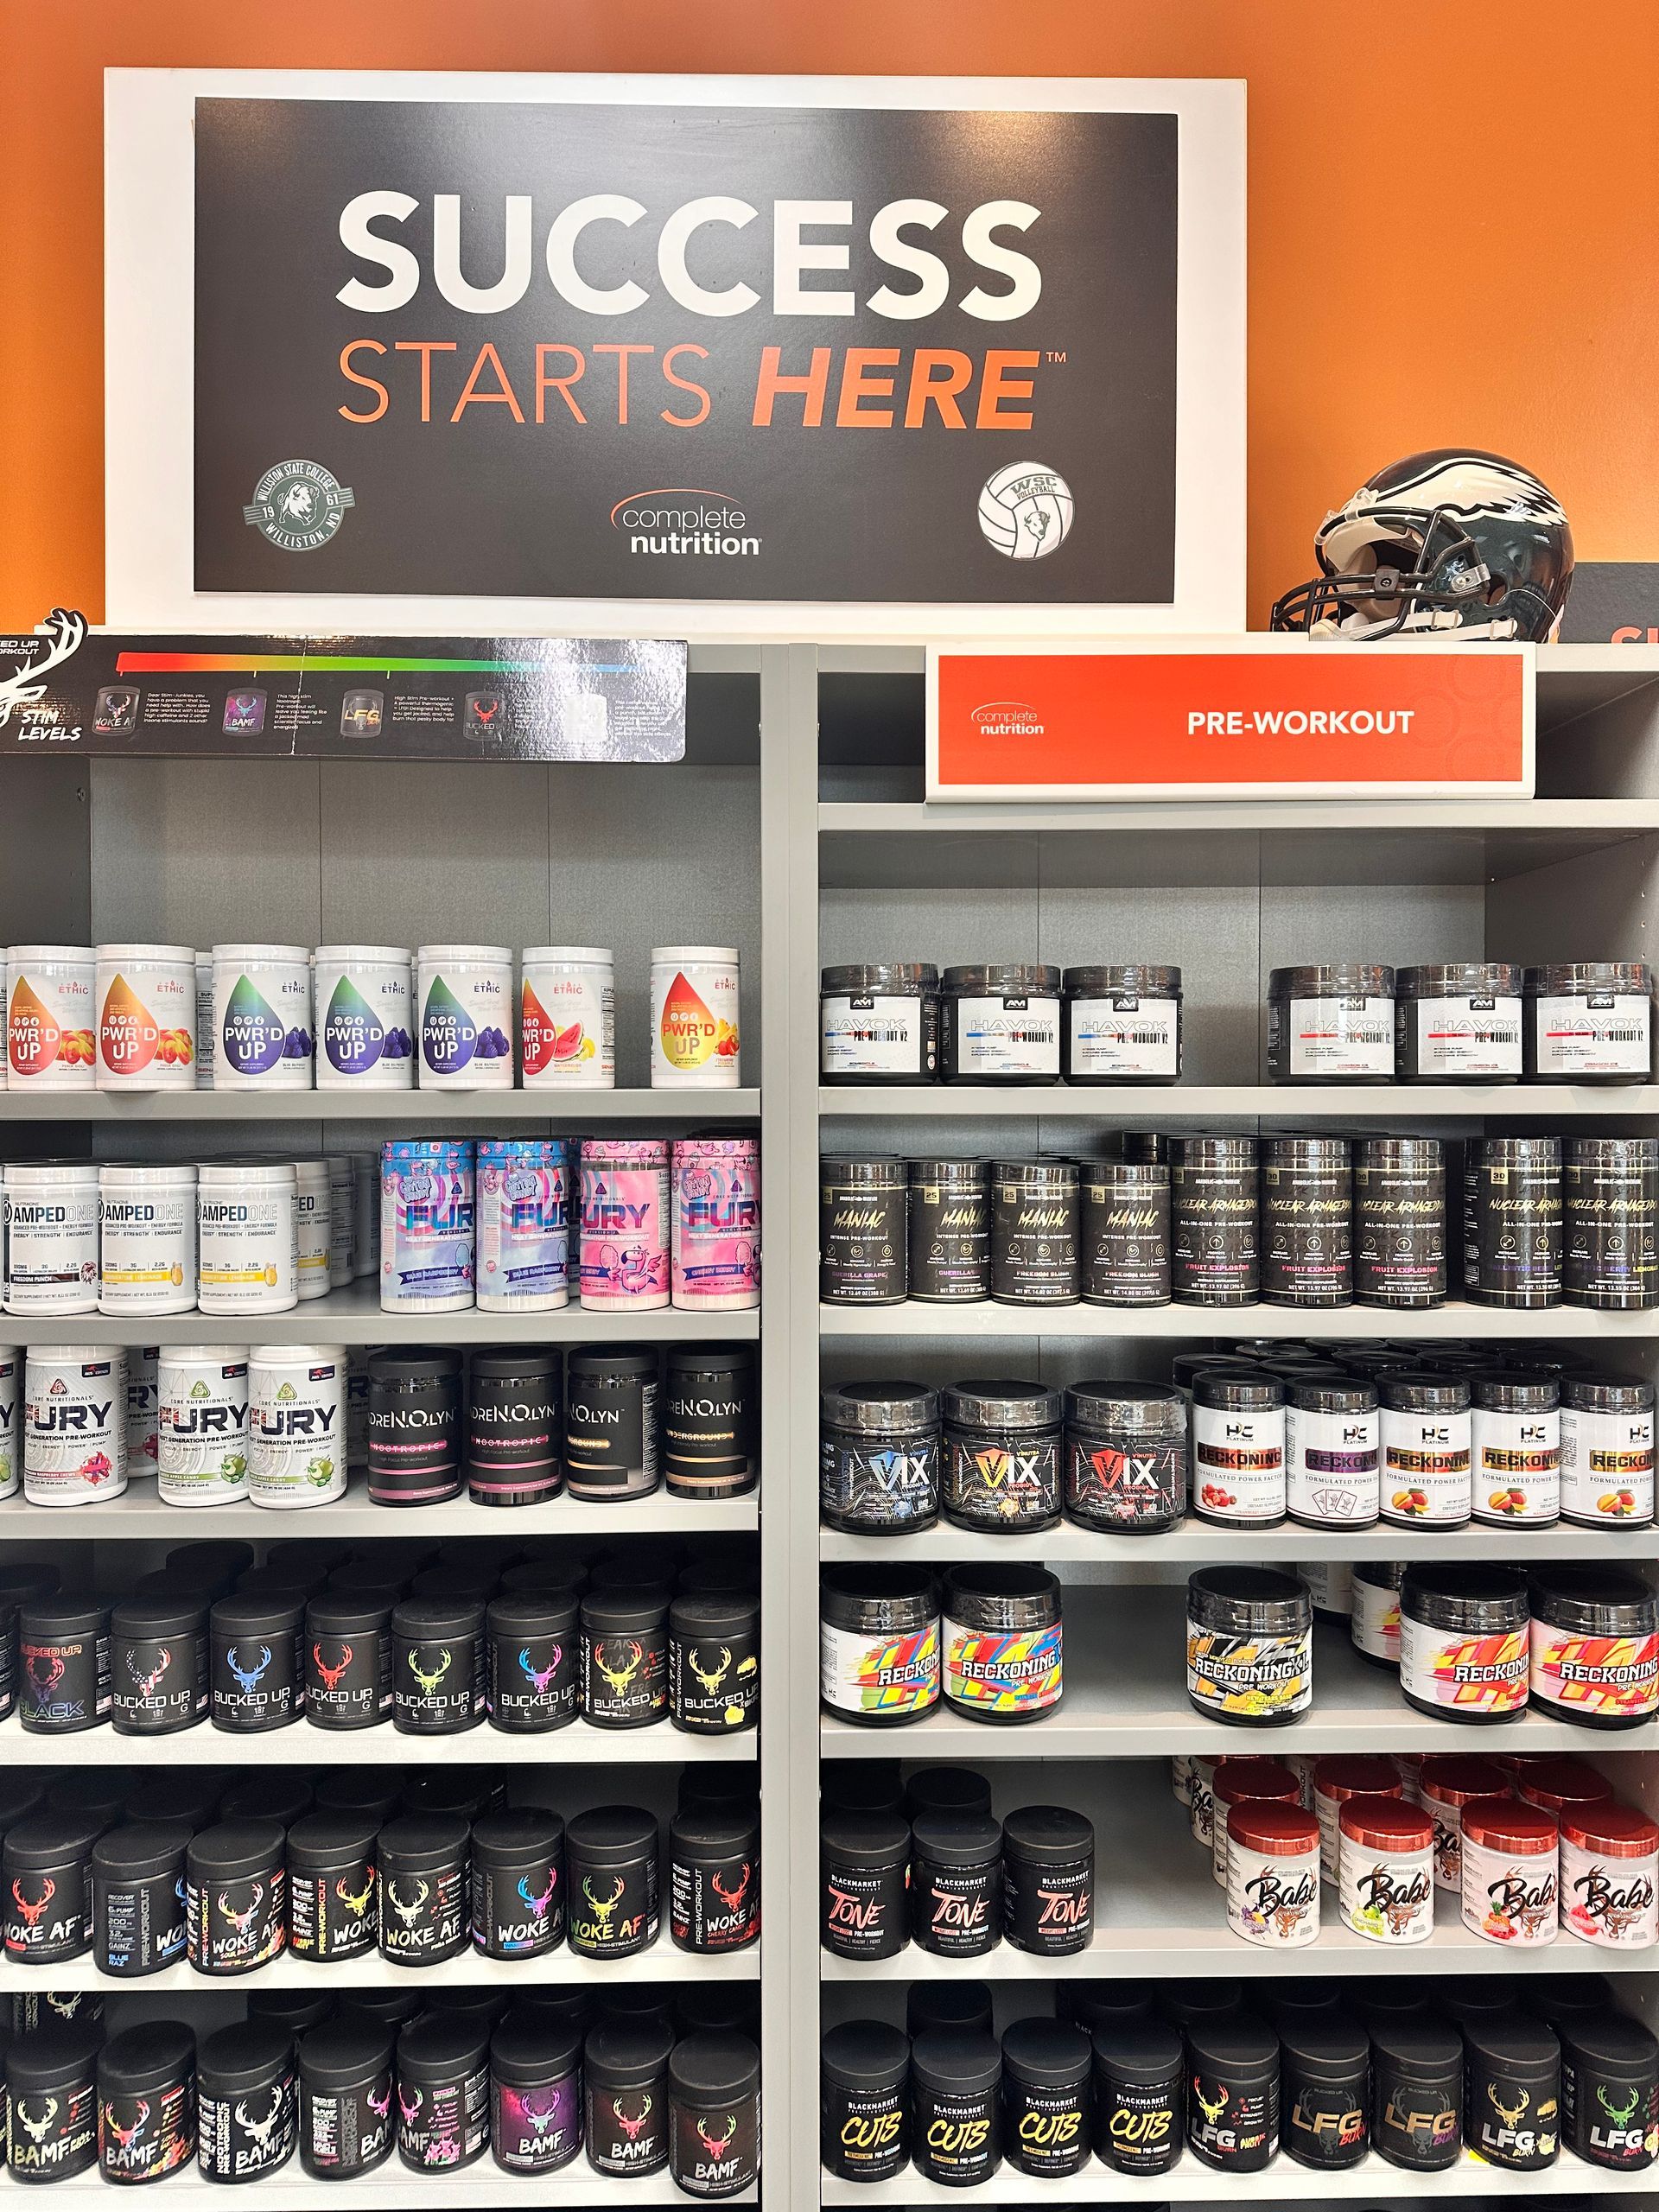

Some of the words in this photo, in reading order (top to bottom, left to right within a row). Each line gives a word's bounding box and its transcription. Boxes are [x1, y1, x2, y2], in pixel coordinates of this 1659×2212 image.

[335, 191, 1042, 320] SUCCESS
[338, 340, 710, 425] STARTS
[257, 467, 284, 501] WILLISTON
[283, 462, 304, 475] STATE
[305, 465, 335, 491] COLLEGE
[1010, 476, 1058, 494] WSC
[1017, 486, 1055, 500] VOLLEYBALL
[263, 505, 275, 518] 19
[326, 493, 339, 505] 61
[622, 503, 745, 533] complete
[265, 522, 330, 548] WILLISTON,
[326, 512, 340, 529] ND
[22, 710, 60, 724] STIM
[232, 718, 256, 727] BAMF
[345, 709, 379, 721] LFG
[976, 711, 1038, 724] complete
[1187, 710, 1414, 735] PRE-WORKOUT
[18, 727, 83, 741] LEVELS
[980, 723, 1045, 734] nutrition
[59, 985, 89, 994] ETHIC
[156, 984, 185, 994] ETHIC
[282, 985, 305, 994] ETHIC
[382, 986, 405, 995] ETHIC
[474, 985, 501, 994] ETHIC
[554, 985, 583, 994] ETHIC
[715, 982, 736, 990] ETHIC
[826, 1018, 906, 1032] HAVOK
[971, 1019, 1053, 1032] HAVOK
[1081, 1021, 1167, 1033] HAVOK
[1305, 1020, 1389, 1032] HAVOK
[1433, 1020, 1518, 1032] HAVOK
[1551, 1018, 1643, 1031] HAVOK
[17, 1042, 41, 1059] UP
[111, 1041, 139, 1059] UP
[238, 1042, 267, 1059] UP
[340, 1042, 367, 1059] UP
[434, 1042, 458, 1059] UP
[524, 1043, 540, 1060] UP
[675, 1037, 701, 1055] UP
[833, 1210, 887, 1230] MANIAC
[1017, 1209, 1069, 1229] MANIAC
[1106, 1209, 1160, 1229] MANIAC
[373, 1442, 440, 1452] NOOTROPIC
[475, 1436, 543, 1447] NOOTROPIC
[1388, 1473, 1427, 1482] FORMULATED
[1257, 1679, 1291, 1690] WORKOUT
[114, 1694, 167, 1710] BUCKED
[214, 1691, 267, 1707] BUCKED
[306, 1688, 350, 1702] BUCKED
[395, 1694, 448, 1708] BUCKED
[501, 1693, 552, 1706] BUCKED
[594, 1693, 647, 1708] BUCKED
[684, 1693, 743, 1709] BUCKED
[830, 1873, 882, 1887] BLACKMARKET
[935, 1877, 987, 1886] BLACKMARKET
[1042, 1872, 1090, 1885] BLACKMARKET
[1245, 1872, 1317, 1917] Babe
[1357, 1872, 1430, 1918] Babe
[1488, 1872, 1556, 1917] Babe
[1573, 1873, 1654, 1918] Babe
[695, 1868, 703, 1946] PRE-WORKOUT
[828, 1886, 886, 1929] TONE
[931, 1887, 990, 1931] TONE
[1037, 1888, 1091, 1925] TONE
[3, 1924, 45, 1942] WOKE
[49, 1920, 73, 1938] AF
[387, 1927, 435, 1947] WOKE
[440, 1913, 460, 1937] AF
[498, 1921, 549, 1942] WOKE
[570, 1920, 616, 1941] WOKE
[620, 1916, 642, 1937] AF
[707, 1913, 747, 1933] WOKE
[213, 1929, 257, 1954] WOKE
[262, 1919, 276, 1940] AF
[848, 2094, 899, 2112] BLACKMARKET
[1026, 2095, 1077, 2107] BLACKMARKET
[1116, 2093, 1168, 2107] BLACKMARKET
[933, 2103, 986, 2115] BLACKMARKET
[841, 2111, 903, 2147] CUTS
[1019, 2111, 1083, 2144] CUTS
[1109, 2108, 1171, 2141] CUTS
[926, 2119, 990, 2151] CUTS
[1191, 2121, 1236, 2148] LFG
[236, 2133, 284, 2170] BAMF
[519, 2132, 563, 2155] BAMF
[612, 2139, 654, 2160] BAMF
[1512, 2146, 1535, 2158] BURN
[1622, 2146, 1643, 2157] BURN
[15, 2141, 68, 2165] BAMF
[106, 2139, 157, 2168] BAMF
[695, 2159, 740, 2181] BAMF
